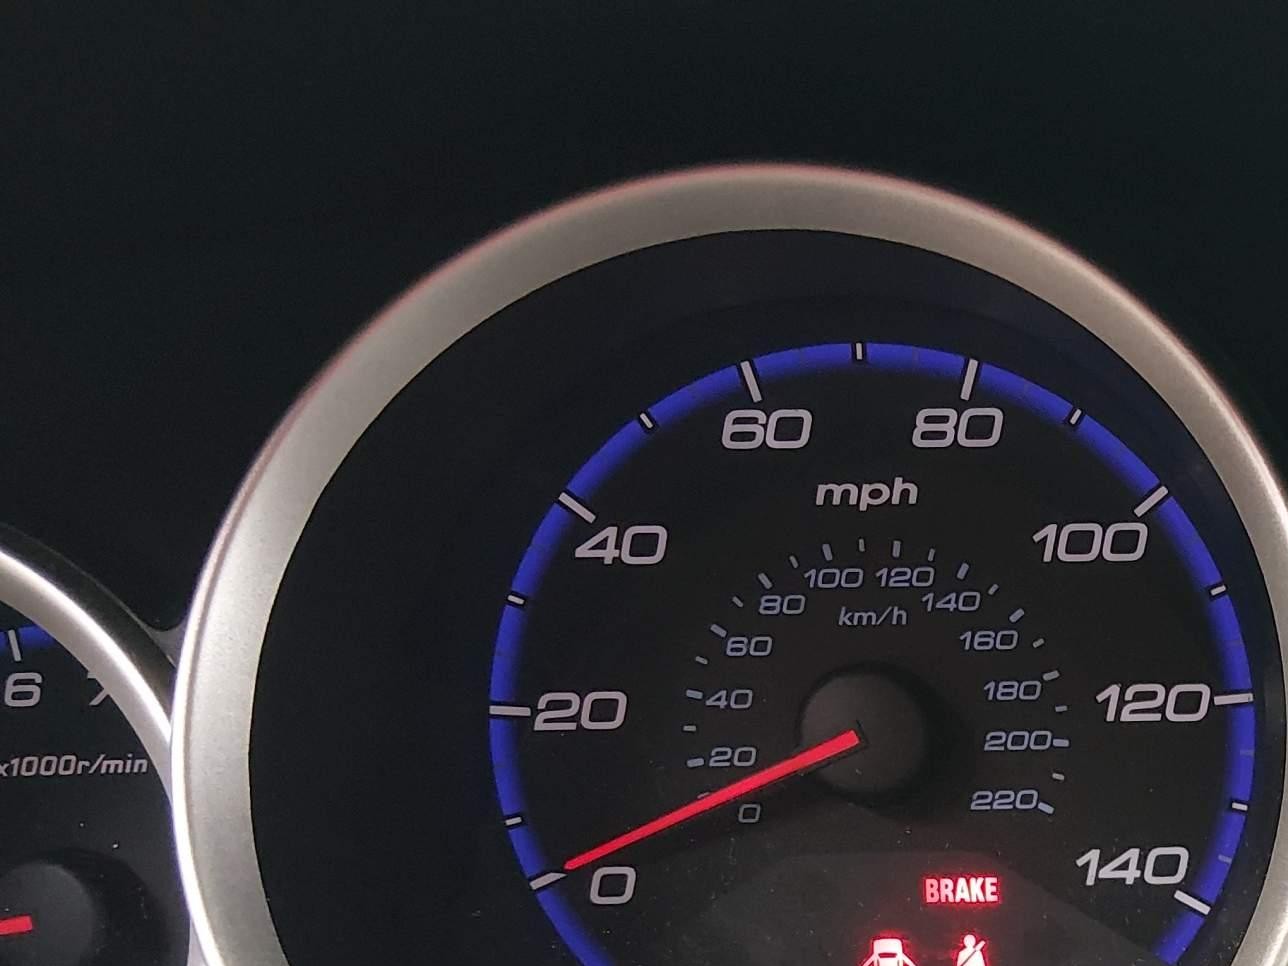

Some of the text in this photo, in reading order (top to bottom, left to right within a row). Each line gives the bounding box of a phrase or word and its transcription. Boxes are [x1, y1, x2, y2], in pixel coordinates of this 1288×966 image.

[721, 409, 812, 450] 60
[912, 407, 1003, 448] 80
[815, 477, 919, 512] mph
[575, 524, 668, 565] 40
[1032, 521, 1149, 563] 100
[804, 568, 863, 588] 100
[875, 566, 934, 587] 120
[759, 595, 806, 615] 80
[922, 591, 981, 612] 140
[838, 605, 908, 627] km/h
[725, 636, 773, 657] 60
[960, 631, 1019, 652] 160
[3, 672, 42, 707] 6
[706, 690, 753, 710] 40
[984, 681, 1042, 702] 180
[533, 691, 628, 731] 20
[1096, 682, 1210, 723] 120
[984, 732, 1052, 752] 200
[708, 747, 757, 767] 20
[970, 790, 1039, 811] 220
[738, 805, 761, 824] 0
[1076, 846, 1189, 886] 140
[589, 869, 636, 905] 0
[924, 876, 999, 904] BRAKE
